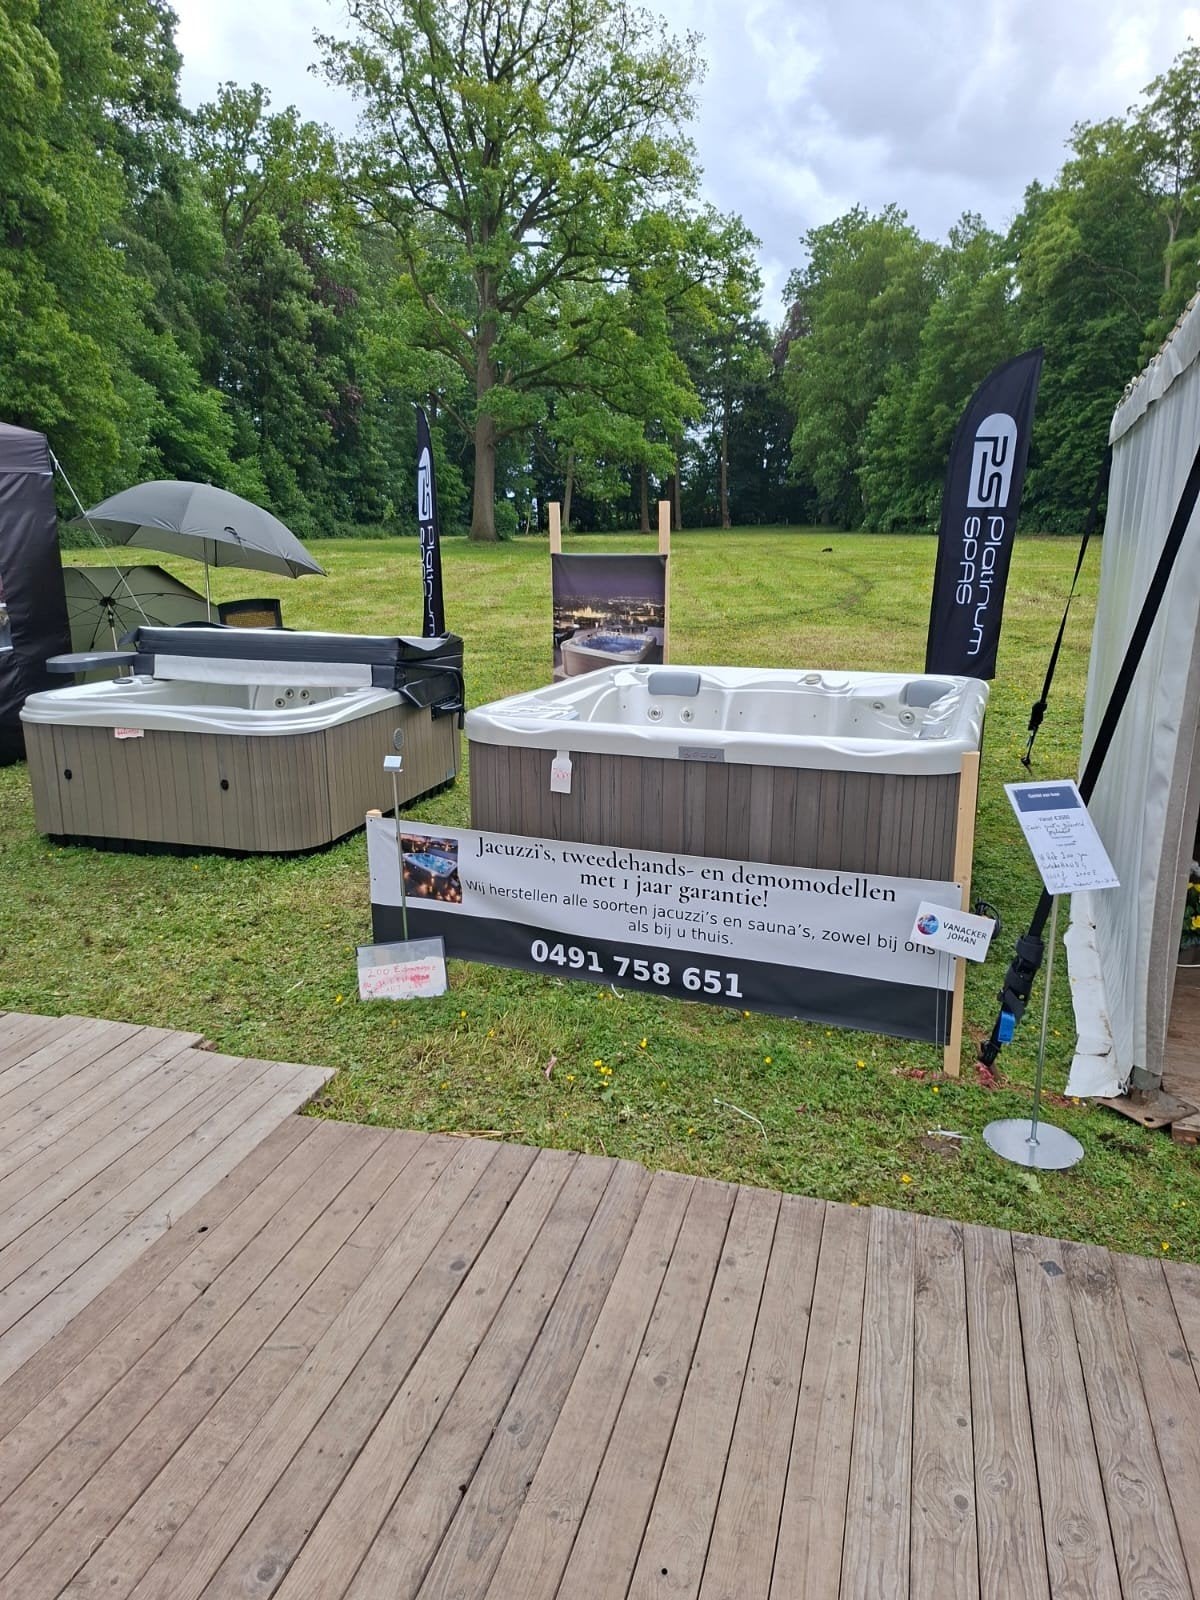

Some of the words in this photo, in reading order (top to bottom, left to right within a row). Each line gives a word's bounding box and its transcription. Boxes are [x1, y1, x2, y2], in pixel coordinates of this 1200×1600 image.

[967, 516, 1005, 655] Platinum
[476, 837, 556, 863] Jacuzzi's,
[562, 851, 694, 876] tweedehands-
[701, 868, 724, 881] en
[732, 865, 896, 902] demomodellen
[580, 873, 616, 888] met
[623, 879, 629, 890] 1
[635, 875, 673, 898] jaar
[679, 885, 768, 907] garantie!
[465, 880, 486, 895] Wij
[489, 884, 558, 903] herstellen
[563, 894, 588, 907] alle
[593, 899, 648, 915] soorten
[652, 904, 718, 925] jacuzzi's
[724, 917, 742, 928] en
[748, 920, 816, 940] sauna's,
[822, 930, 871, 946] zowel
[877, 934, 898, 953] bij
[628, 920, 649, 933] als
[654, 922, 672, 939] bij
[677, 928, 686, 938] u
[691, 927, 734, 945] thuis.
[943, 921, 987, 940] VANACKER
[946, 932, 977, 946] JOHAN
[530, 939, 603, 973] 0491
[613, 956, 671, 985] 758
[682, 967, 743, 998] 651
